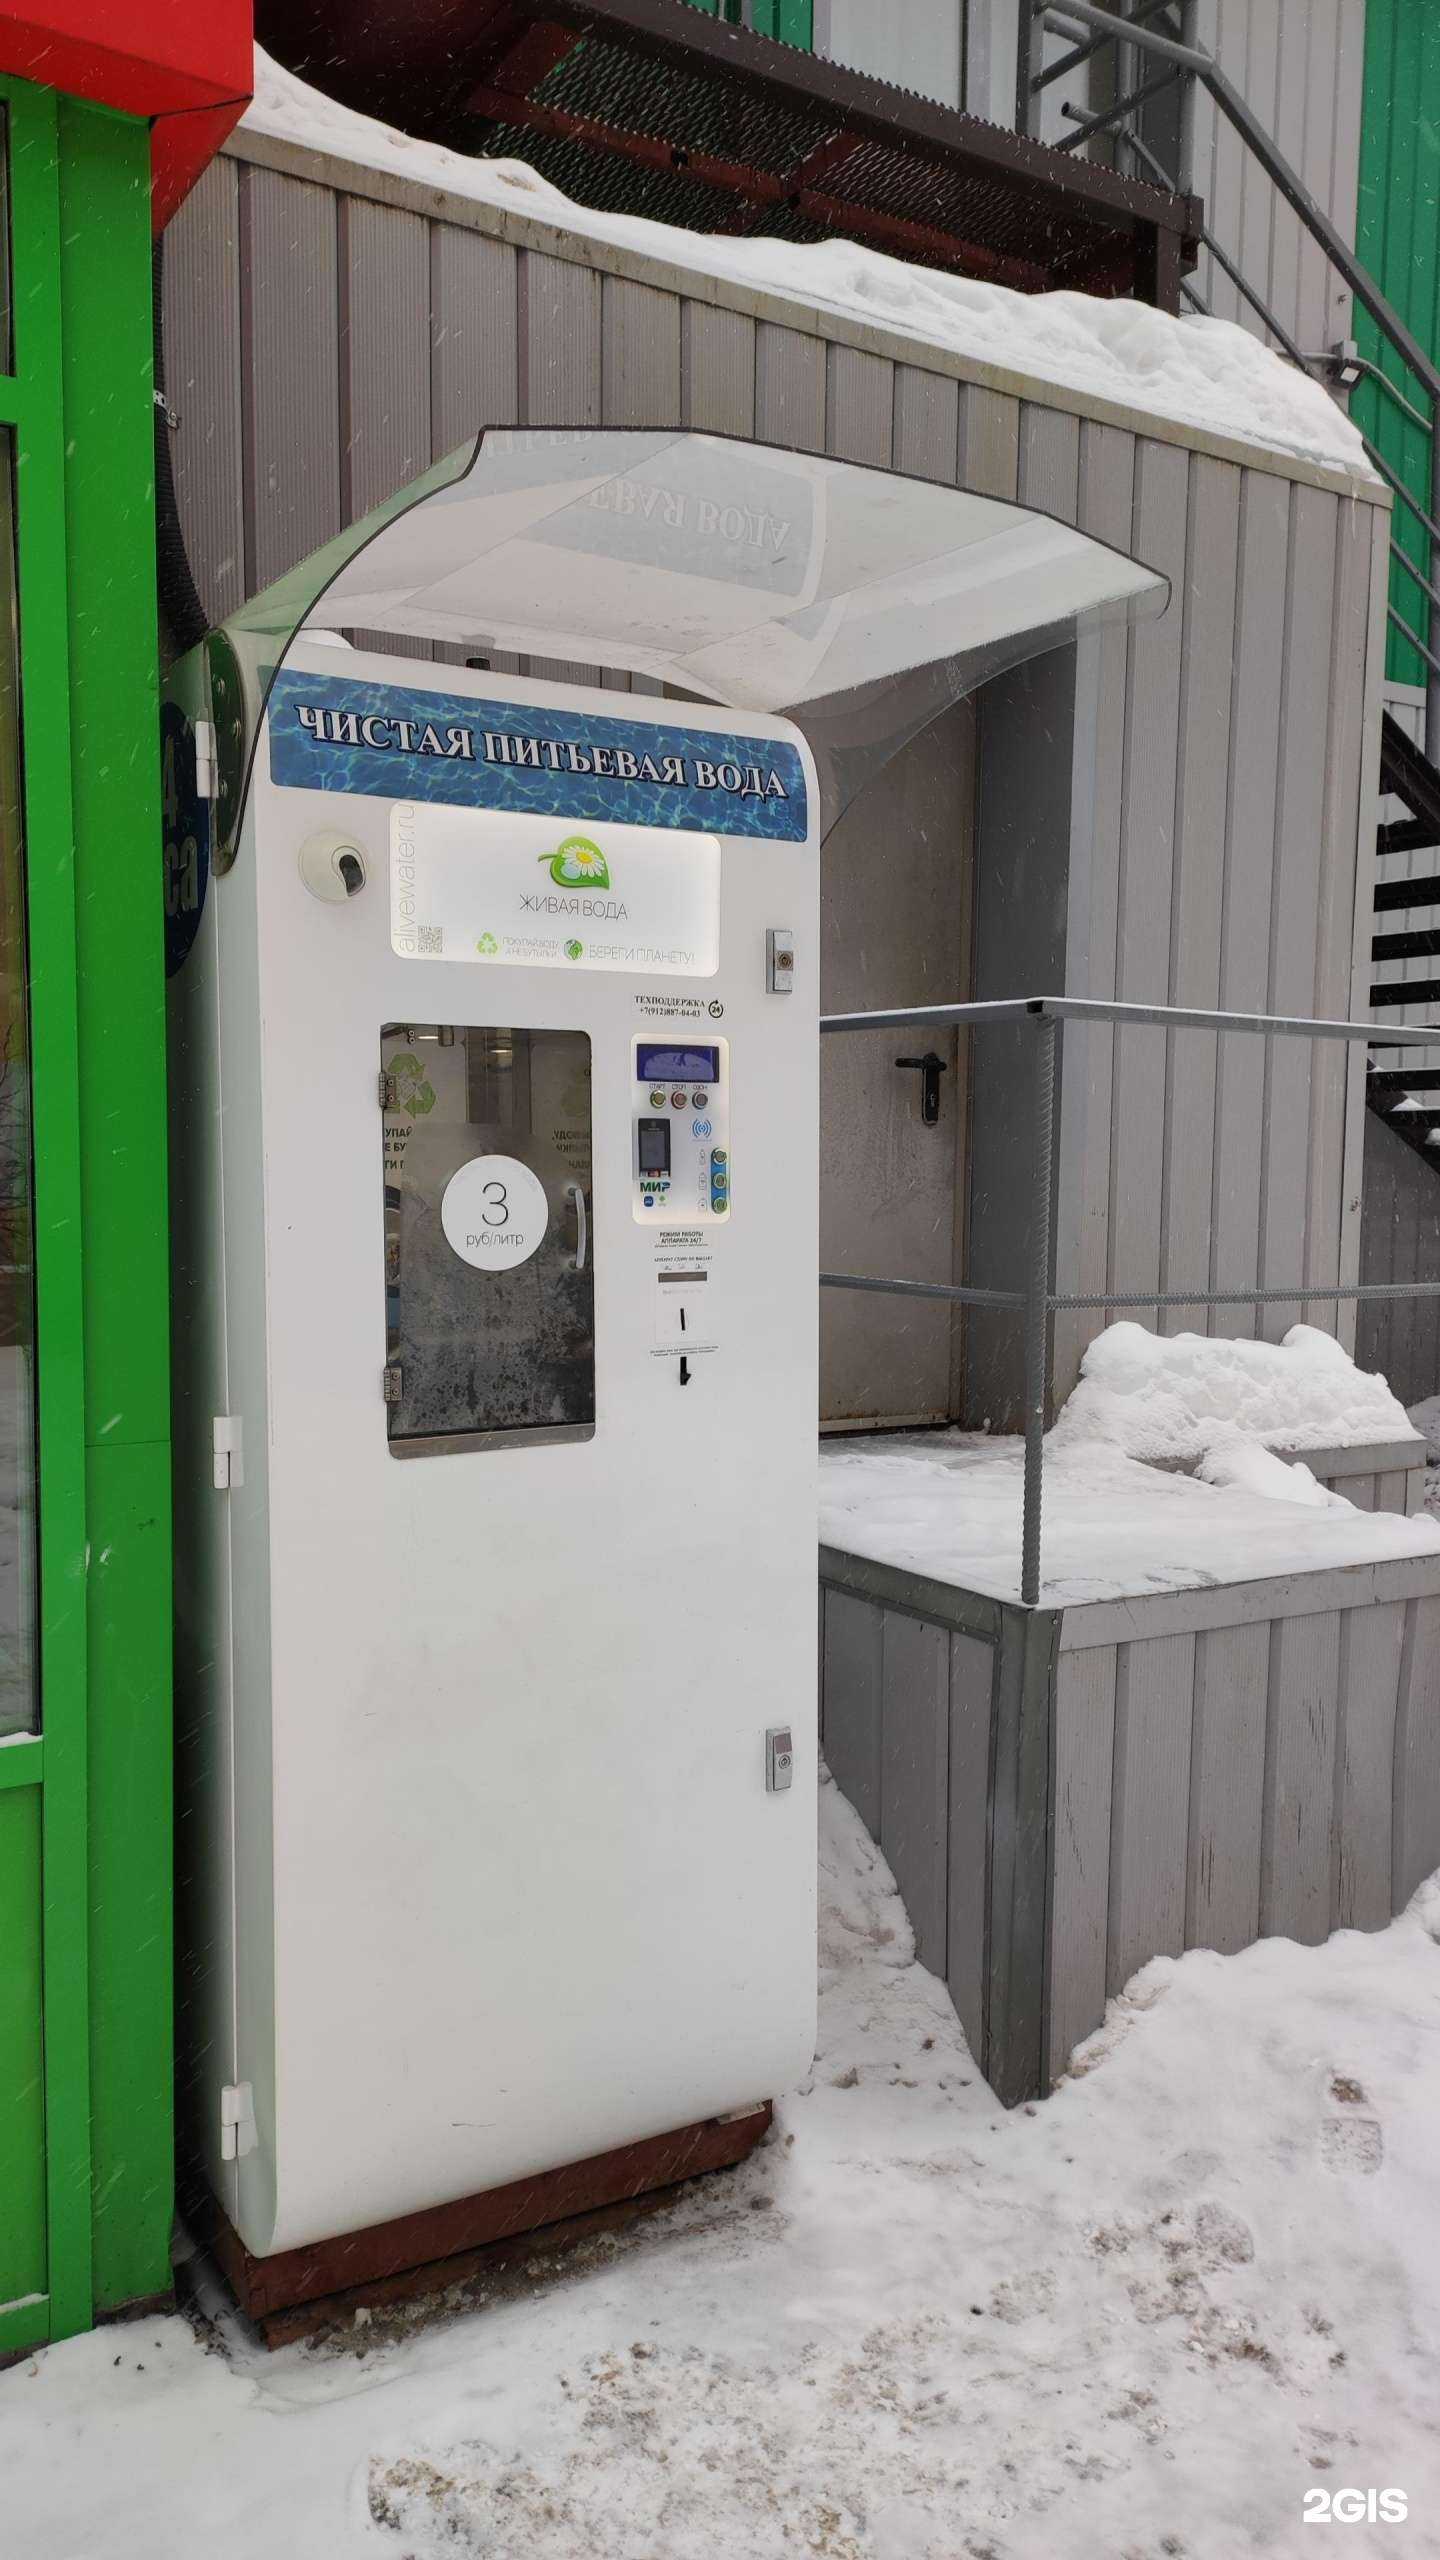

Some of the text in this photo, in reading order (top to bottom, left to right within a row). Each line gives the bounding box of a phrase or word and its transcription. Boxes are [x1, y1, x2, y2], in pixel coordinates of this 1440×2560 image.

[295, 704, 790, 803] ЧИСТАЯ ПИТЬЕВАЯ ВОДА
[393, 804, 416, 953] alivewater.ru
[519, 893, 628, 921] ЖИВАЯ ВОДА
[589, 943, 696, 965] БЕРЕГИ ПЛАНЕТУ!
[634, 995, 706, 1008] ТЕХПОДДЕРЖКА
[640, 1181, 671, 1193] МИР
[481, 1181, 509, 1227] 3
[466, 1232, 524, 1248] руб/литр
